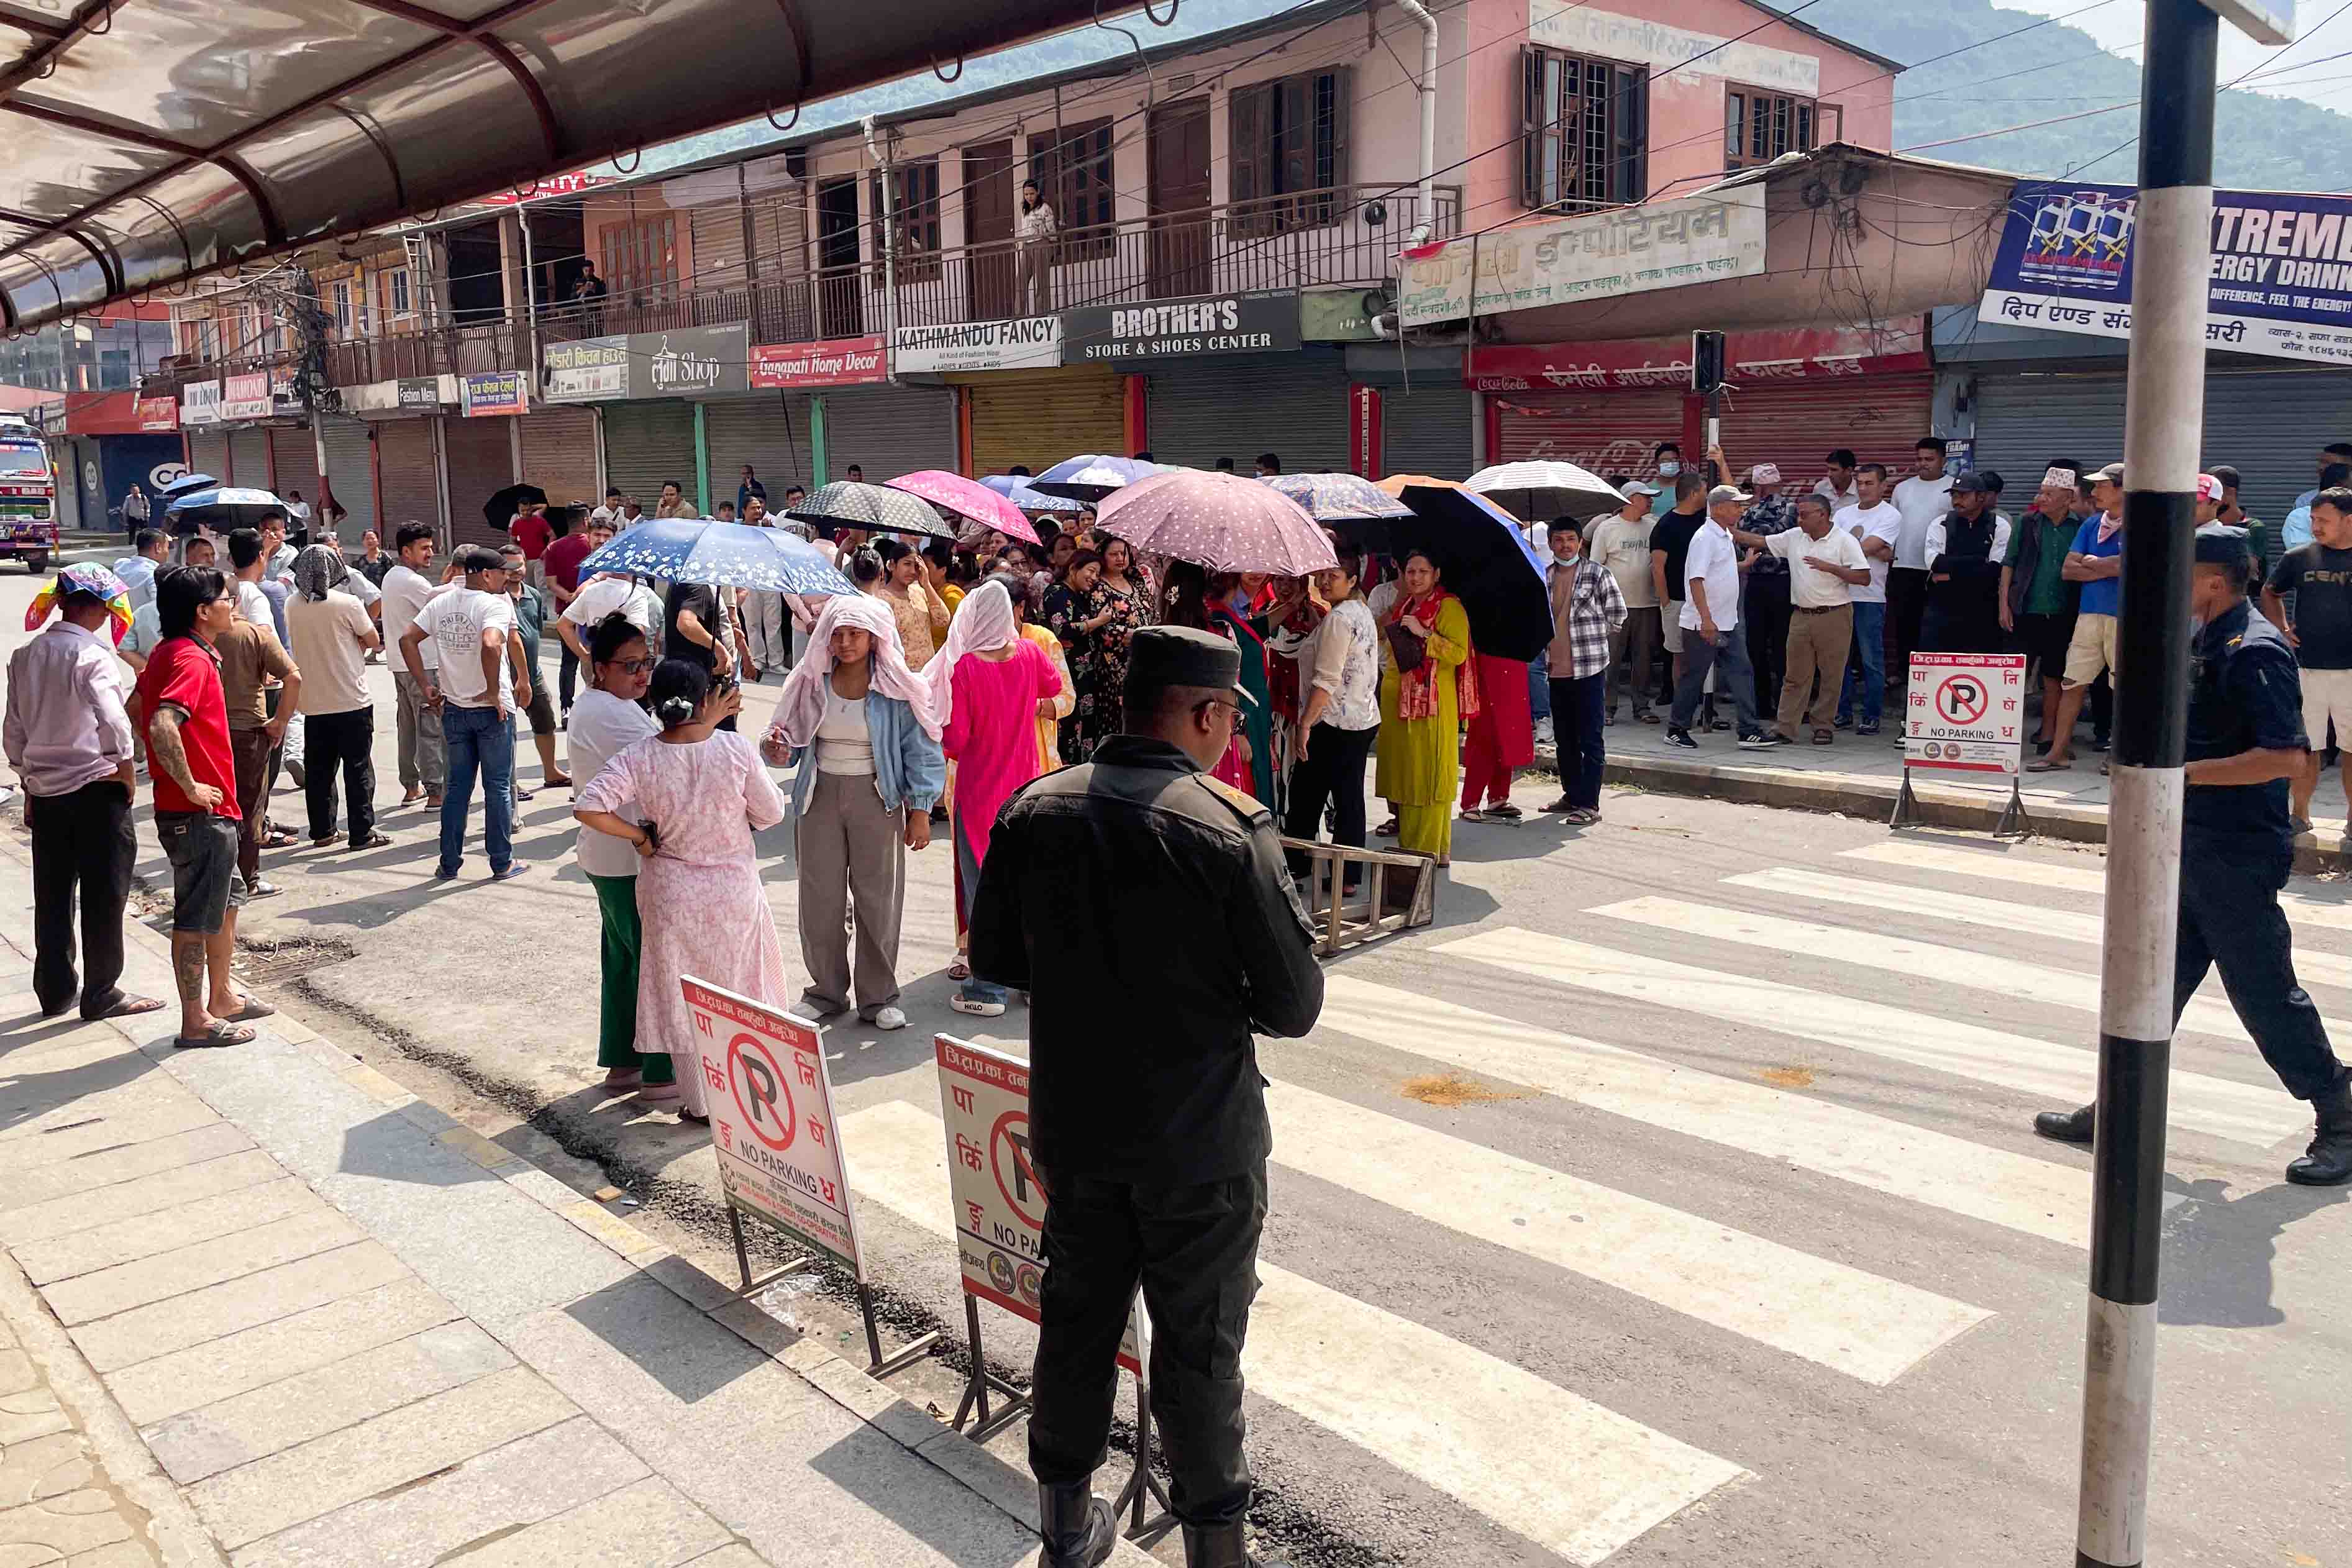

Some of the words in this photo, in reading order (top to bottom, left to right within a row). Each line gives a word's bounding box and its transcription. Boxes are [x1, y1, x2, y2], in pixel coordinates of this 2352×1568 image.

[2001, 296, 2043, 320] दिप
[2049, 306, 2096, 325] एण्ड
[2268, 293, 2289, 306] FEEL
[2292, 295, 2310, 308] THE
[1111, 300, 1238, 339] BROTHER'S
[899, 324, 994, 351] KATHMANDU
[999, 318, 1054, 344] FANCY
[1085, 342, 1131, 358] STORE
[1136, 342, 1146, 355] &
[1152, 338, 1201, 354] SHOES
[1208, 333, 1272, 350] CENTER
[681, 352, 721, 387] Shop
[811, 353, 842, 376] Home
[845, 350, 880, 371] Decor
[399, 387, 420, 403] Fashion
[1930, 727, 1945, 737] NO
[1948, 729, 1994, 740] PARKING
[741, 1139, 759, 1164] NO
[760, 1149, 818, 1193] PARKING
[994, 1221, 1016, 1247] NO
